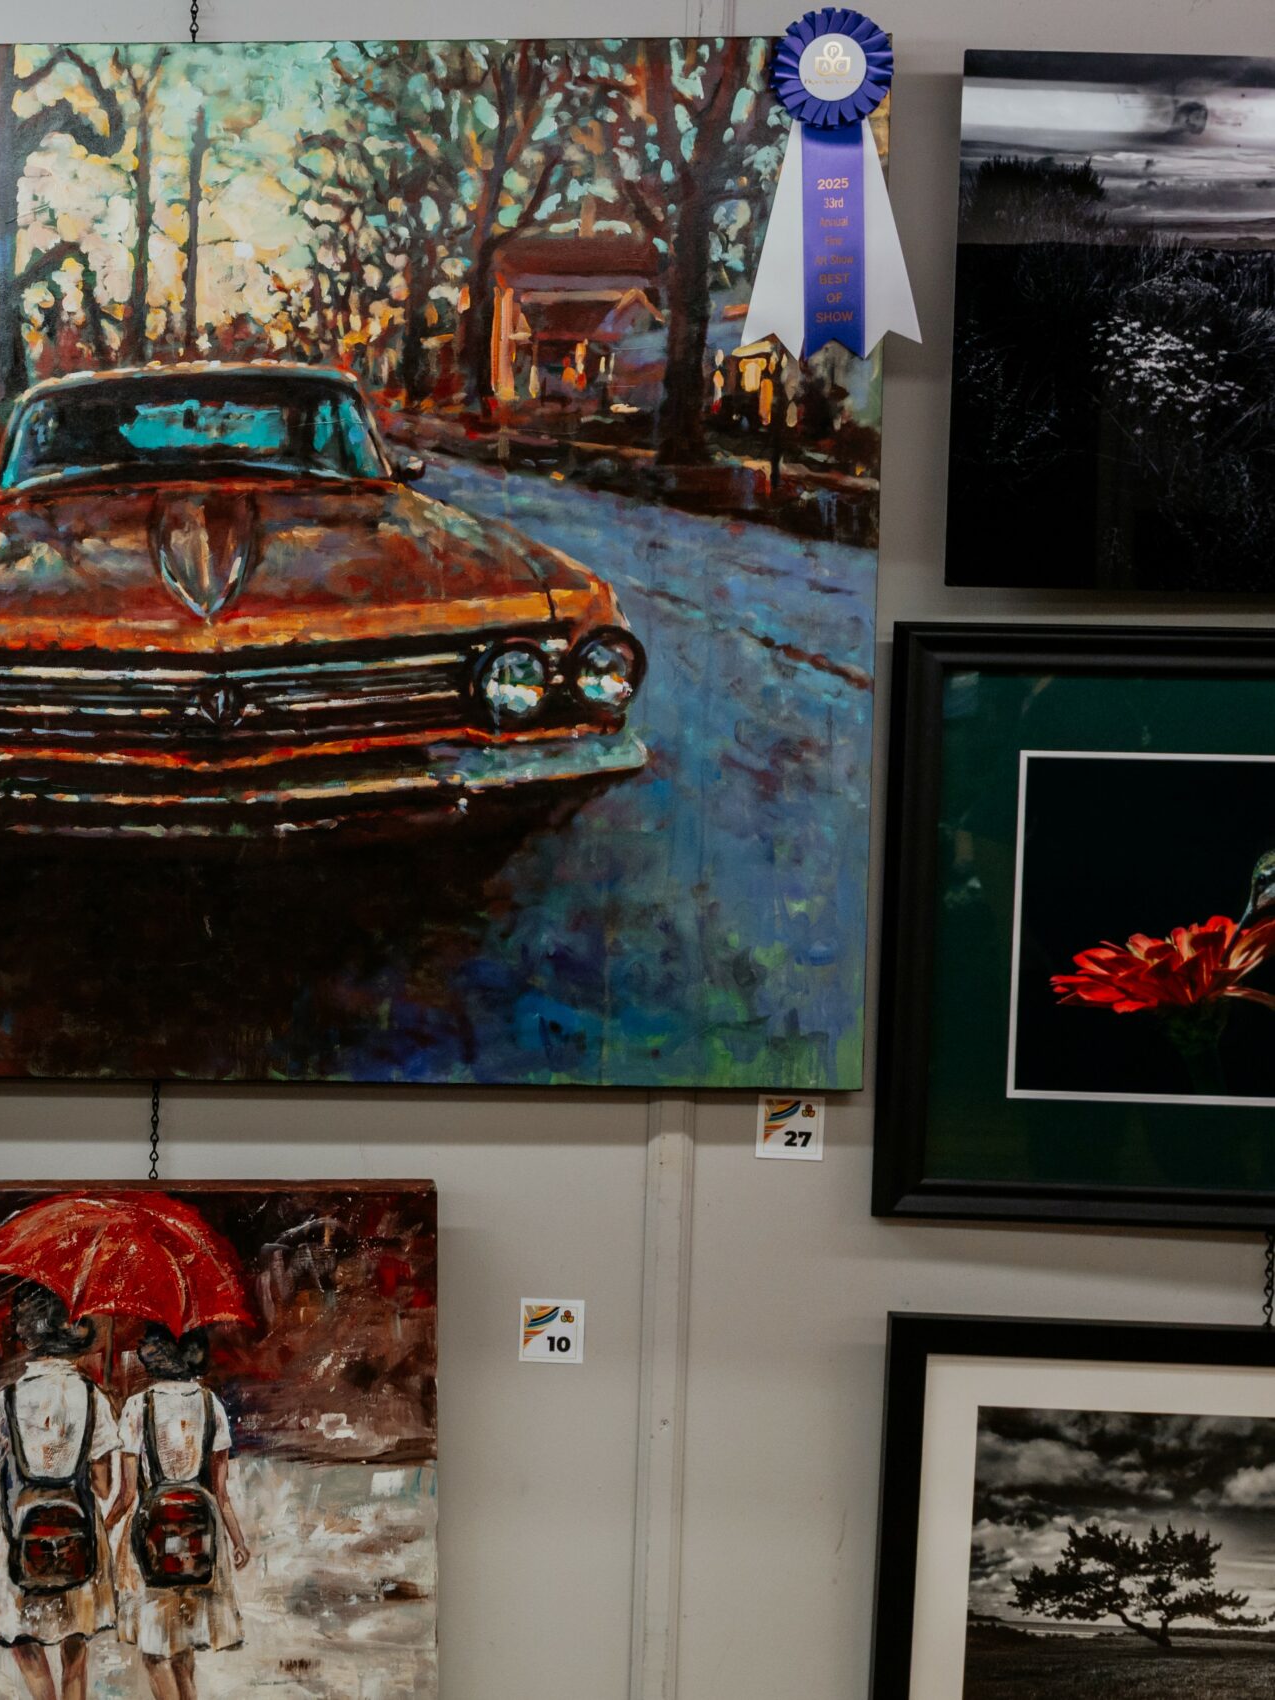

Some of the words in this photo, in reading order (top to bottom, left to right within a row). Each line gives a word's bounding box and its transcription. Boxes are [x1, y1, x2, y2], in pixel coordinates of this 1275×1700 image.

[817, 177, 849, 190] 2025
[824, 196, 844, 208] 33rd
[820, 216, 848, 228] Annual
[819, 272, 850, 285] BEST
[827, 292, 842, 304] OF
[815, 311, 853, 323] SHOW
[784, 1130, 812, 1148] 27
[546, 1336, 571, 1352] 10
